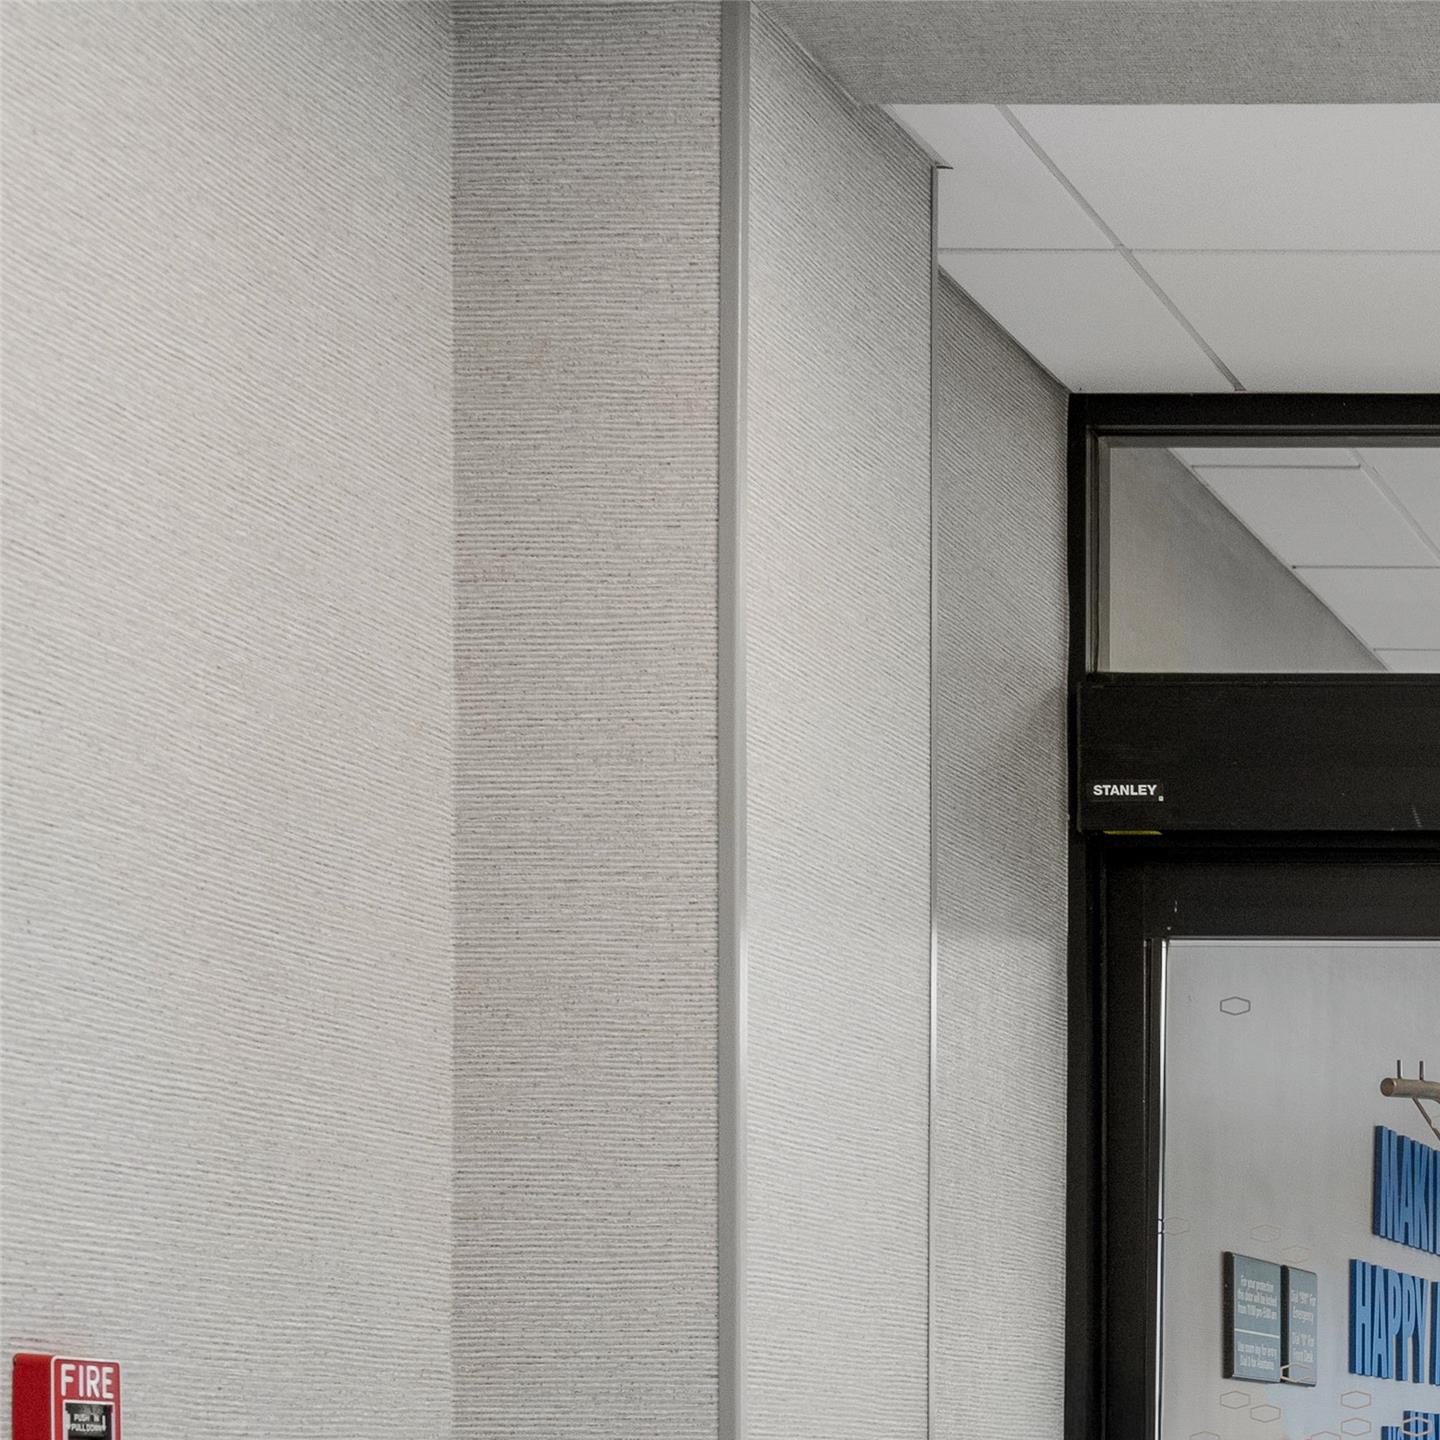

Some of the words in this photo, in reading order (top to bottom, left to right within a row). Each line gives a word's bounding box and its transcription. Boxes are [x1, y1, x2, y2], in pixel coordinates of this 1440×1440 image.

[1092, 784, 1158, 797] STANLEY
[1349, 1258, 1429, 1384] HAPPY
[60, 1363, 115, 1399] FIRE
